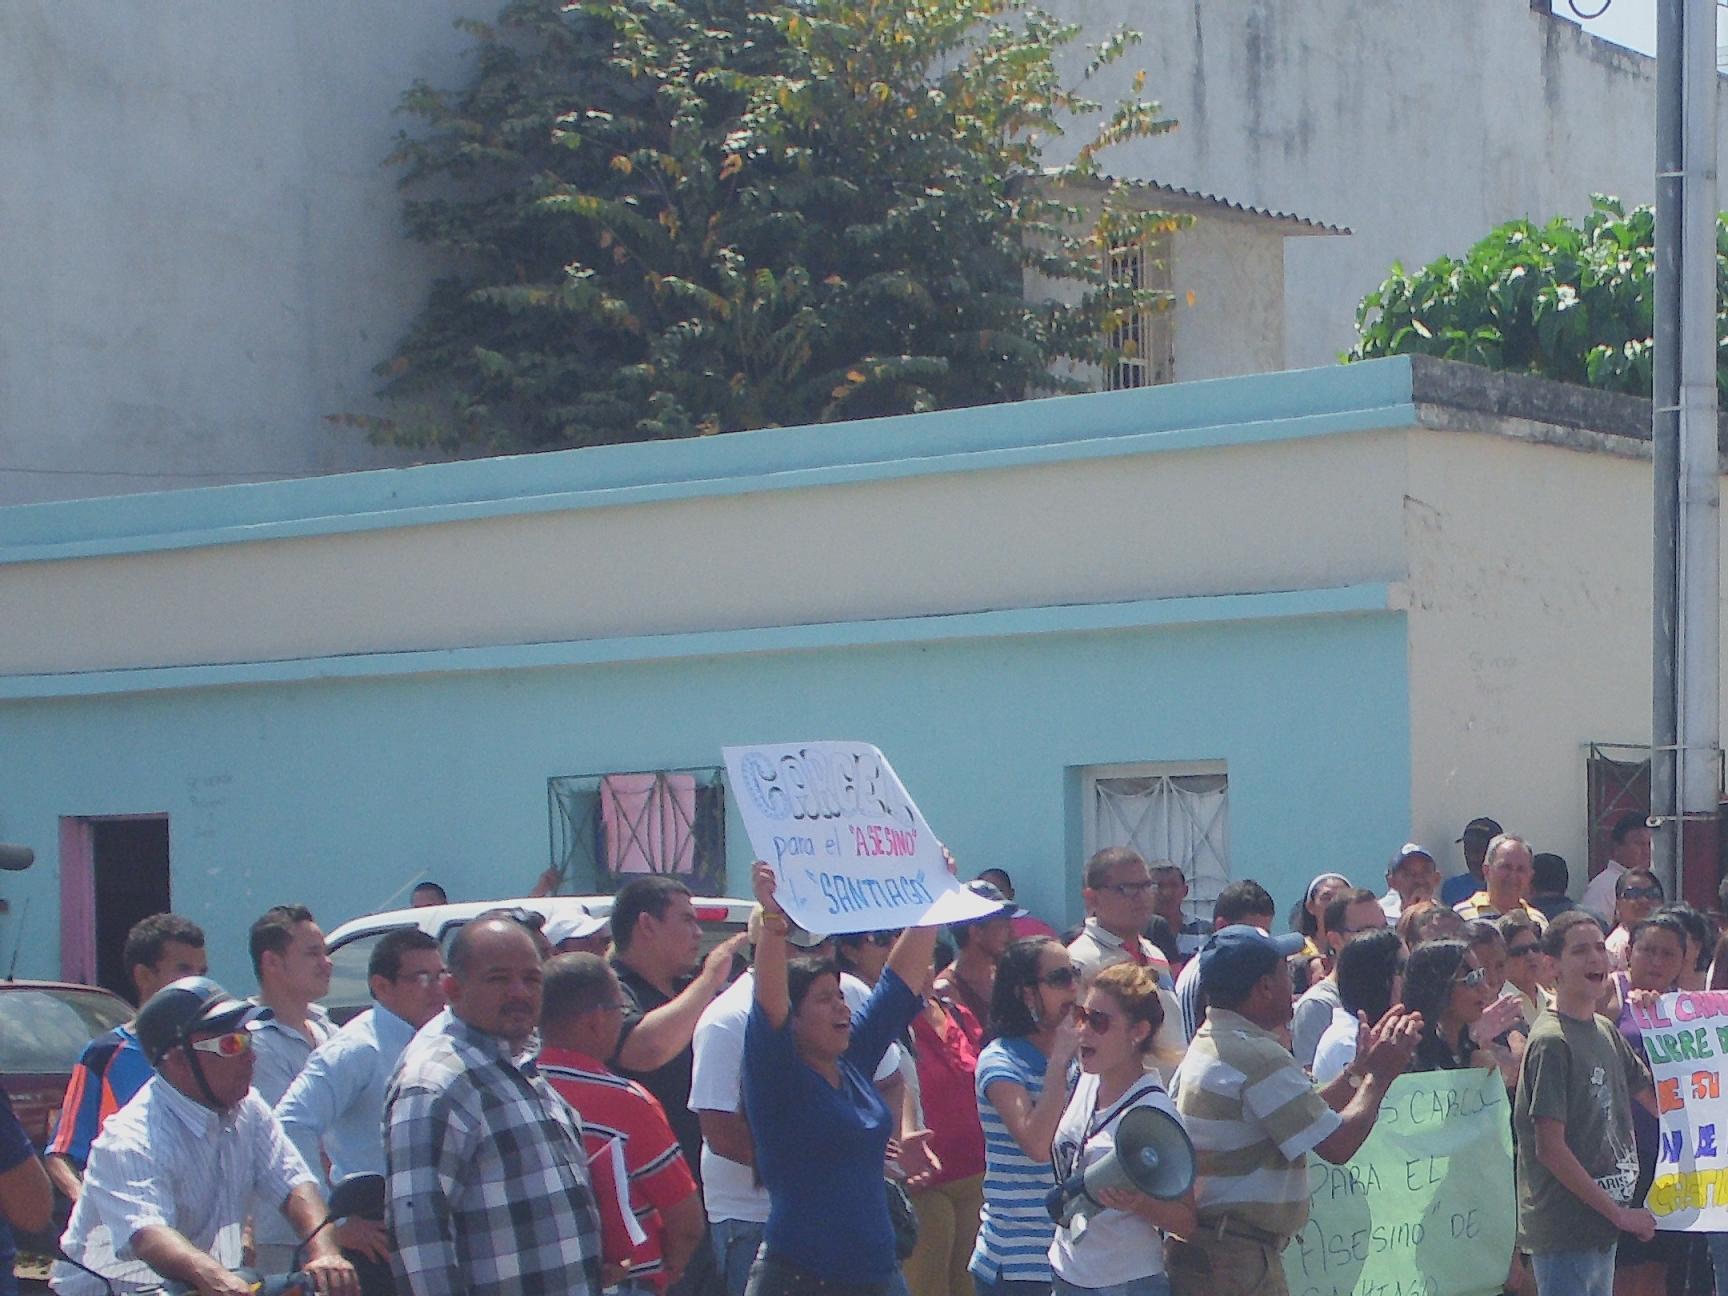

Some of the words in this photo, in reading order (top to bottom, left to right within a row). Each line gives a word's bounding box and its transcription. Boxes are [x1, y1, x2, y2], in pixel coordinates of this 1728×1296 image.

[772, 837, 816, 882] para
[824, 826, 841, 857] el
[1310, 1162, 1382, 1208] PARA
[1405, 1154, 1449, 1192] EL
[1450, 1208, 1481, 1241] DE
